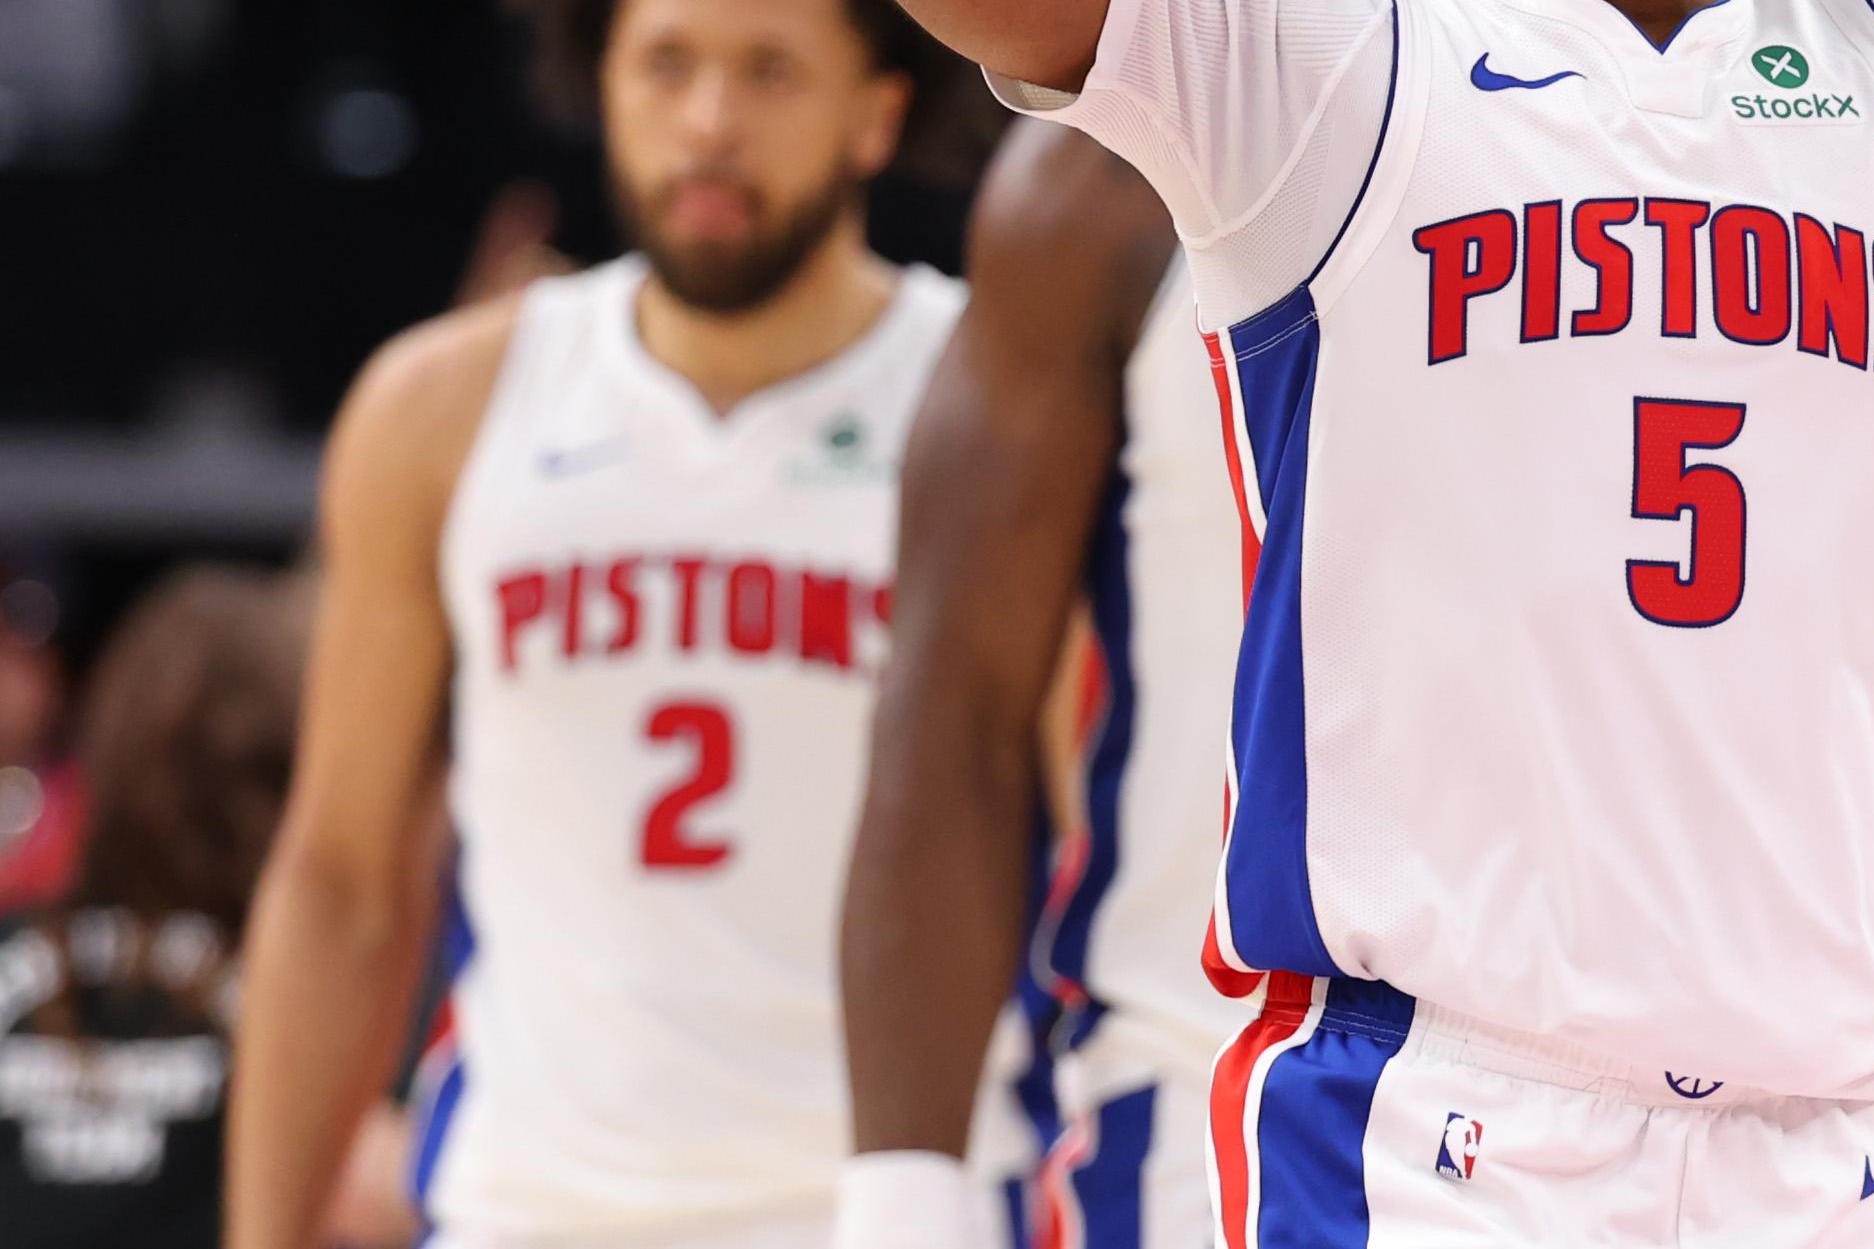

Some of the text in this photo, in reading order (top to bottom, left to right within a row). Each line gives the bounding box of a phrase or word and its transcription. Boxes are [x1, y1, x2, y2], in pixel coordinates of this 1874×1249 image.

[1731, 93, 1860, 119] StockX
[1625, 396, 1747, 628] 5
[636, 695, 739, 874] 2
